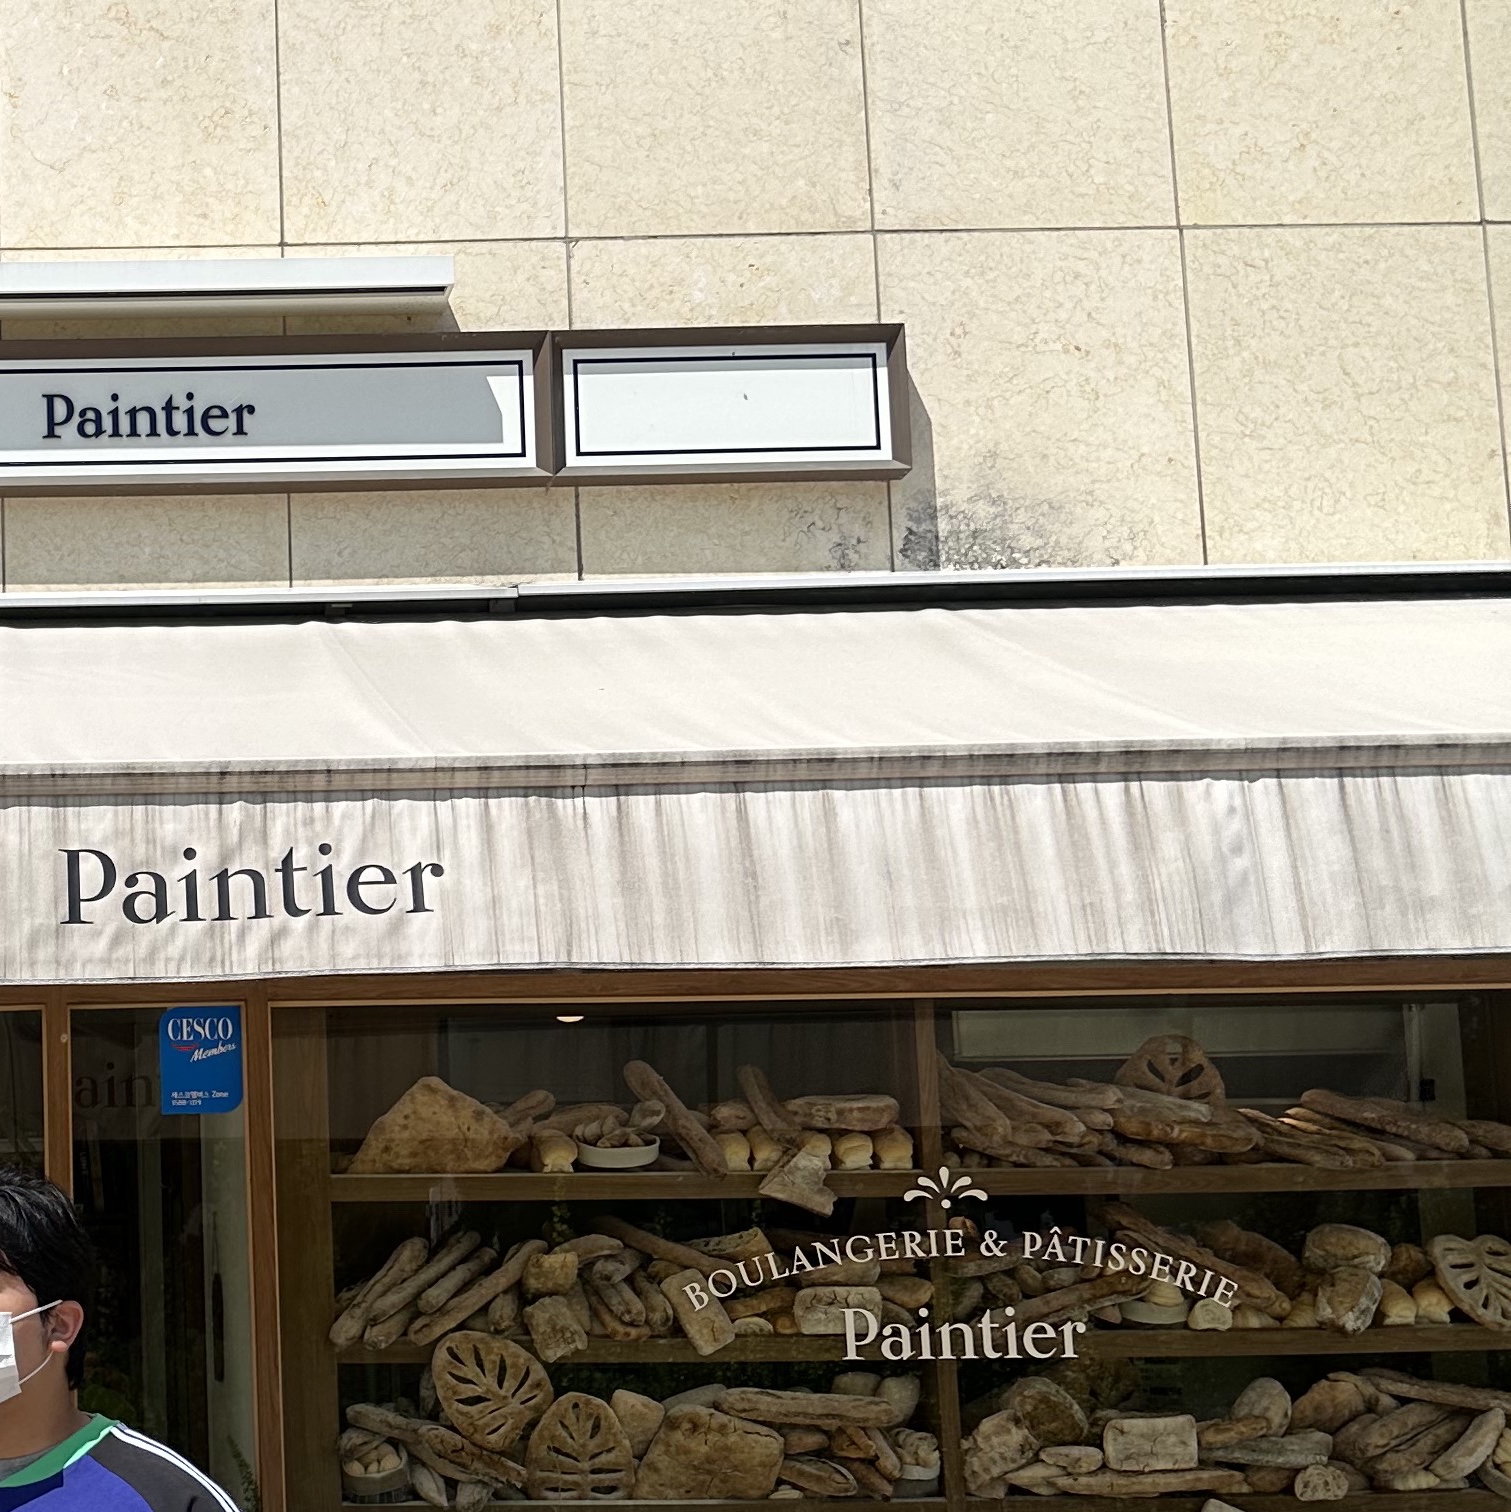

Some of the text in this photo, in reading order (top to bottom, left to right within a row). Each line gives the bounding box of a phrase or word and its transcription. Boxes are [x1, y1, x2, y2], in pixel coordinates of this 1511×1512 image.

[41, 391, 256, 440] Paintier
[58, 842, 445, 926] Paintier
[167, 1016, 234, 1041] CESCO
[189, 1040, 237, 1063] Members
[681, 1226, 1240, 1312] BOULANGERIE & PÂTISSERIE
[840, 1306, 1087, 1362] Paintier
